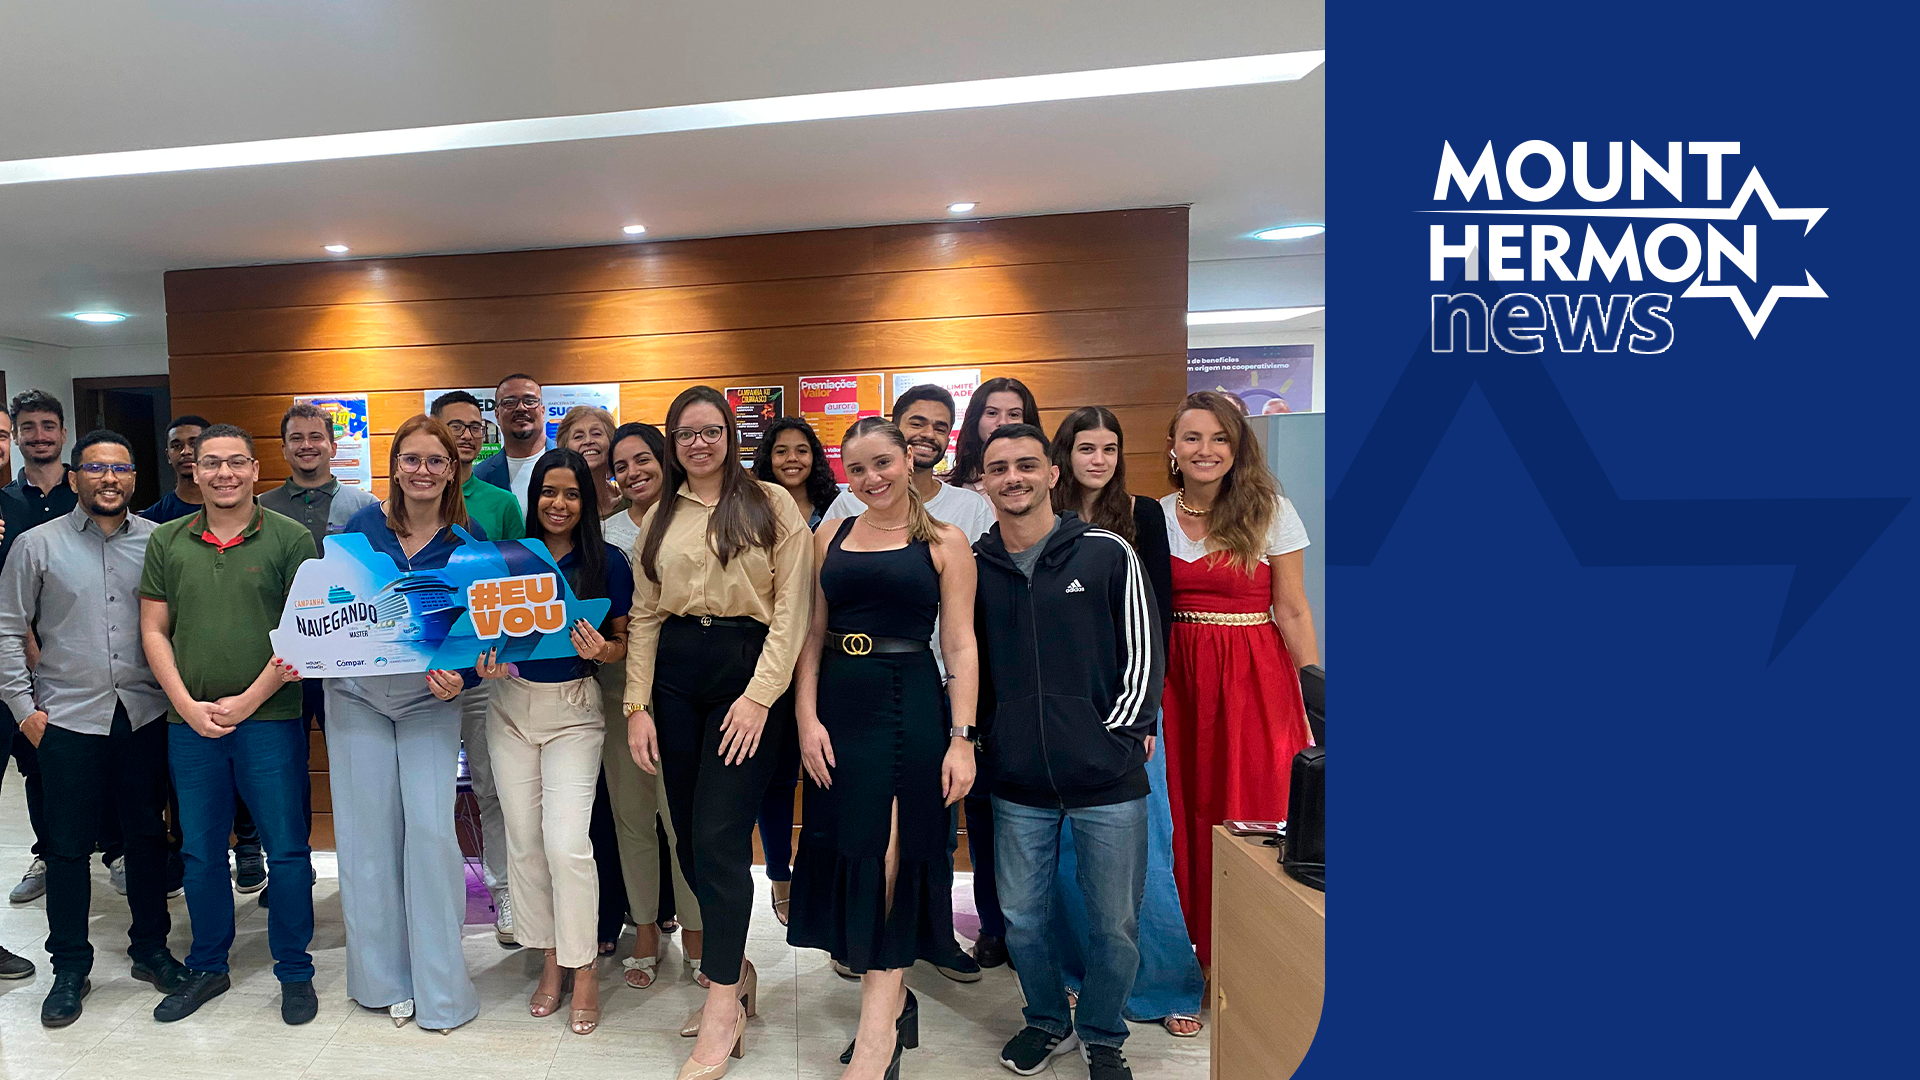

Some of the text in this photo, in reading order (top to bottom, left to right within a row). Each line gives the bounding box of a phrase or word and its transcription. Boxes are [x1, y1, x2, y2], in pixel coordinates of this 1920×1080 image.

[1194, 365, 1220, 373] origem
[1231, 362, 1290, 371] cooperativismo
[801, 379, 857, 391] Premiações
[946, 383, 974, 391] LIMITE
[738, 389, 763, 397] CAMPANHA
[470, 576, 554, 611] #EU
[294, 598, 325, 608] CAMPANHA
[295, 602, 378, 637] NAVEGANDO
[472, 603, 563, 636] VOU
[349, 630, 369, 639] MASTER
